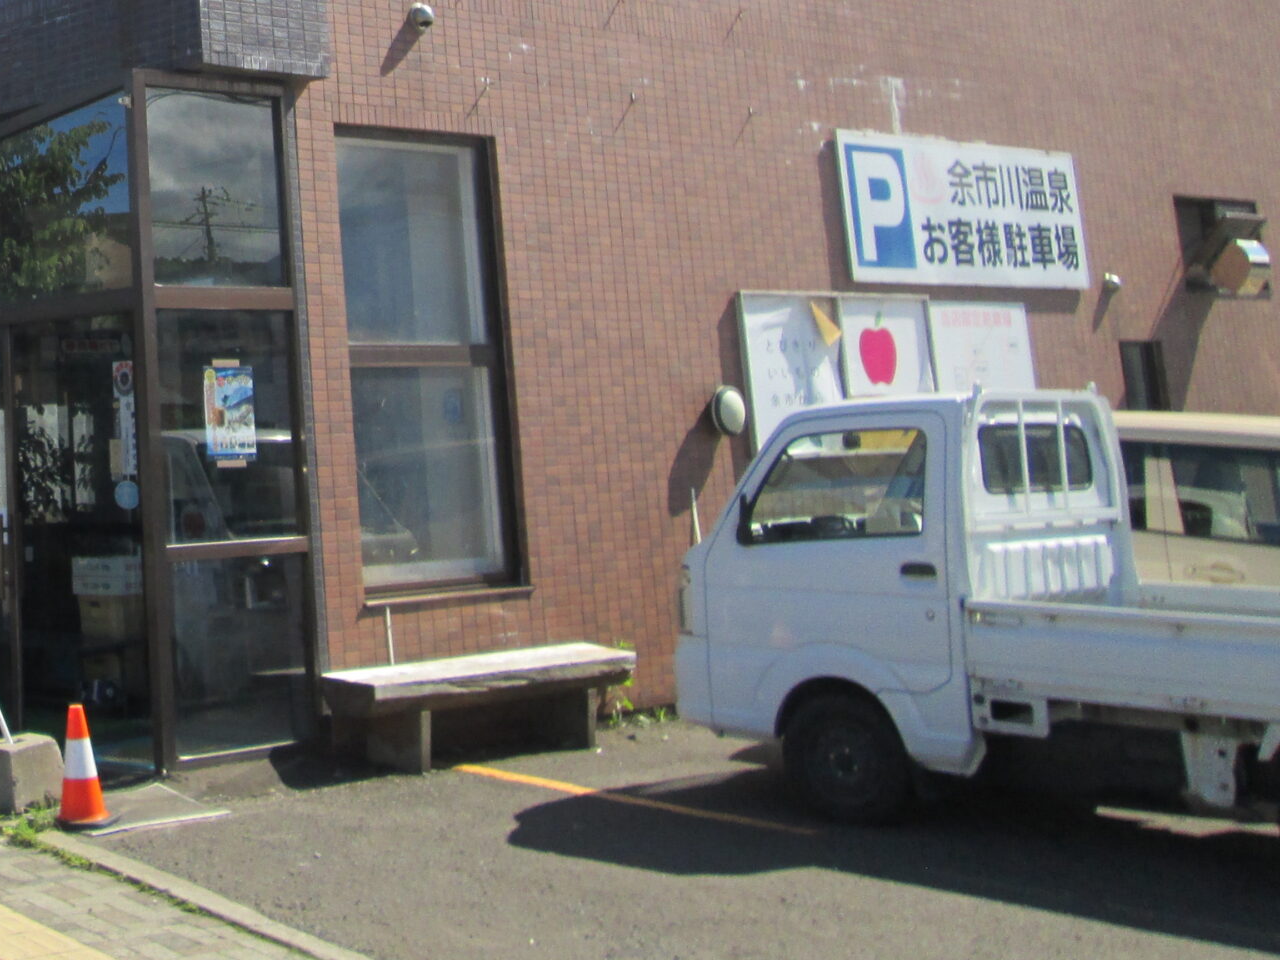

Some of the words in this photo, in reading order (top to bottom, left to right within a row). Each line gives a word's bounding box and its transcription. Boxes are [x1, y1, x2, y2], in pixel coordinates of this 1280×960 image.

[851, 150, 906, 262] P
[946, 159, 1074, 215] 余市川温泉
[921, 216, 1080, 272] お客様駐車場
